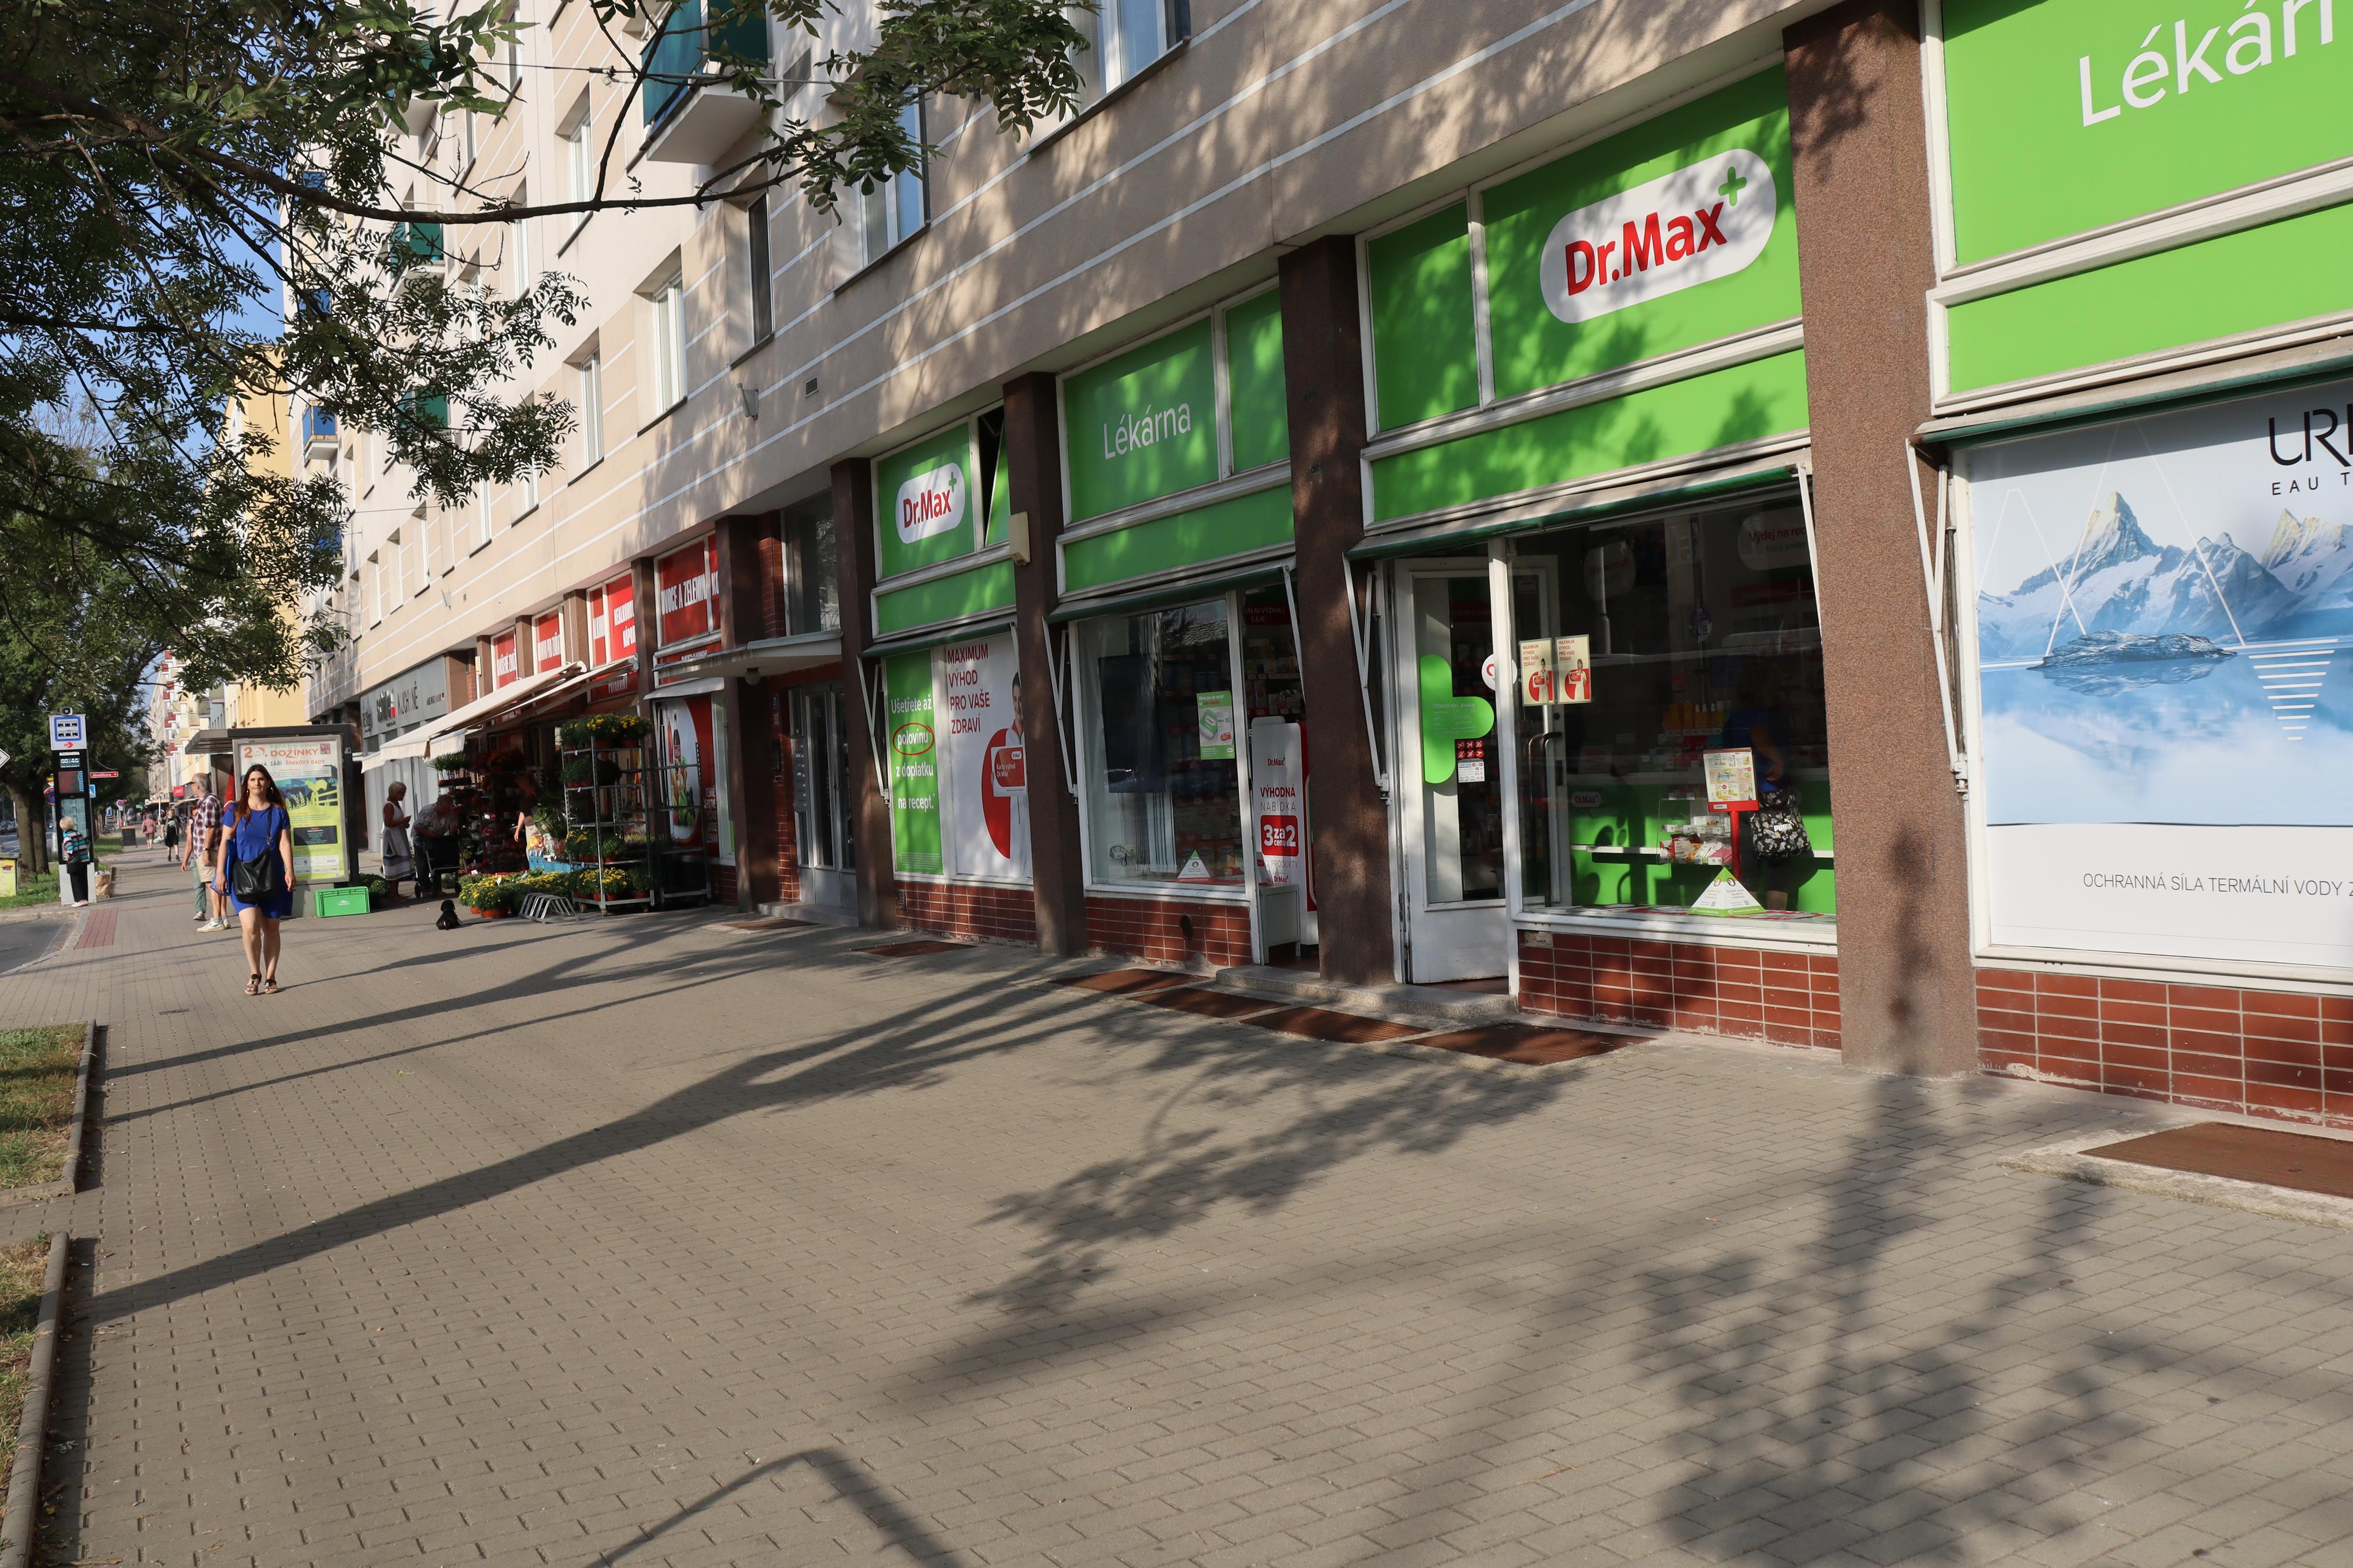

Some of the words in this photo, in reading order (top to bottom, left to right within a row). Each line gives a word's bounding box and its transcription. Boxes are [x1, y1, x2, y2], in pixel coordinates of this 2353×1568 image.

[2079, 0, 2333, 127] Lékár
[1565, 201, 1728, 296] Dr.Max
[1104, 403, 1191, 459] Lékárna
[2272, 476, 2318, 495] EAU
[903, 489, 952, 528] Dr.Max
[661, 585, 678, 615] OVOCE
[678, 583, 683, 609] A
[948, 643, 988, 665] MAXIMUM
[949, 668, 978, 688] VÝHOD
[891, 696, 921, 714] Ušetřete
[923, 694, 932, 709] až
[950, 695, 966, 710] PRO
[968, 689, 990, 709] VAŠE
[951, 713, 980, 734] ZDRAVÍ
[898, 729, 928, 748] polovinu
[271, 748, 318, 758] DOŽÍNKY
[896, 766, 900, 777] z
[902, 762, 933, 780] doplatku
[1260, 784, 1296, 798] VÝHODNÁ
[898, 797, 906, 810] na
[1261, 799, 1296, 812] NABÍDKA
[1264, 824, 1274, 846] 3
[1274, 828, 1285, 839] za
[1285, 825, 1296, 847] 2
[1271, 860, 1298, 869] PRODUKTY
[2083, 872, 2167, 890] OCHRANNÁ
[2171, 873, 2204, 891] SÍLA
[2208, 875, 2289, 894] TERMÁLNÍ
[2294, 879, 2342, 896] VODY
